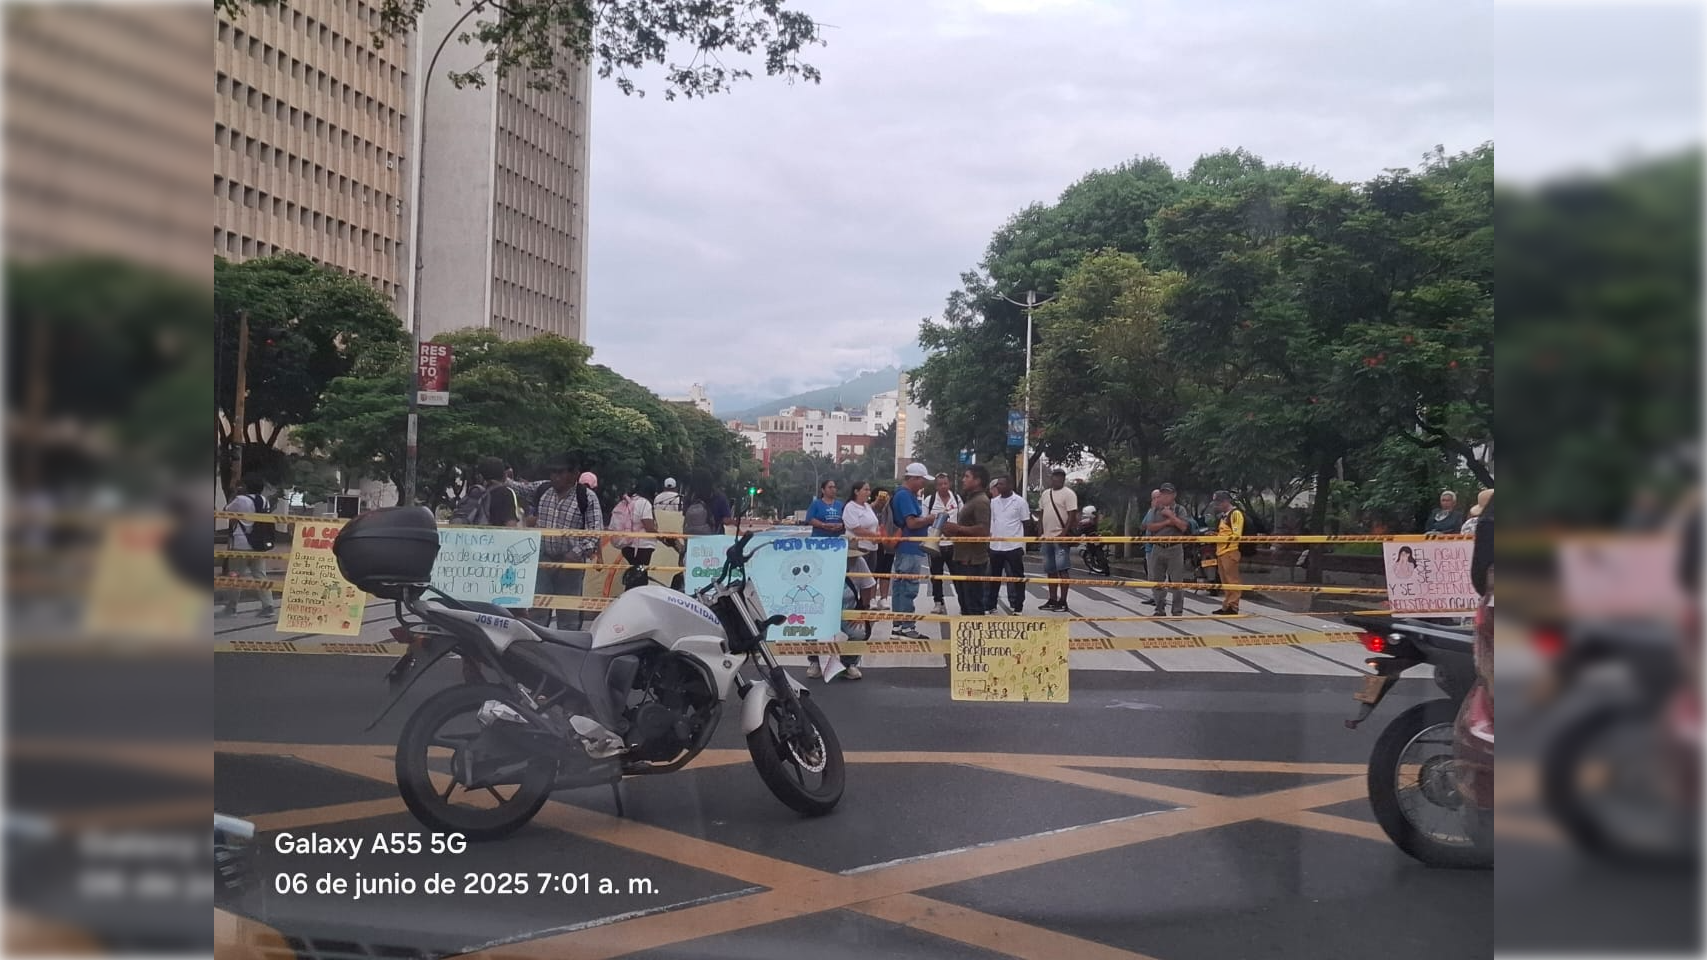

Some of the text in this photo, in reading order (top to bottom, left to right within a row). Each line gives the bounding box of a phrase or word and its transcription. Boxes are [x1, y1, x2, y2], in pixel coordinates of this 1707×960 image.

[421, 345, 447, 356] RES
[420, 356, 438, 366] PE
[420, 366, 437, 377] TO
[457, 548, 469, 562] de
[1414, 548, 1467, 561] EL AGUA
[1417, 560, 1470, 572] SE VENDE
[1418, 571, 1433, 583] SE
[462, 581, 479, 594] en
[1388, 583, 1397, 596] Y
[1400, 583, 1416, 596] SE
[667, 596, 720, 625] MOVILIDAD
[475, 614, 493, 625] JOS
[958, 621, 1047, 632] AGUA RECOLECTADA
[956, 629, 976, 640] CON
[957, 638, 986, 648] SALUD
[957, 646, 1012, 657] SACRIFICADA
[973, 654, 983, 664] EL
[956, 663, 990, 673] CAMINO
